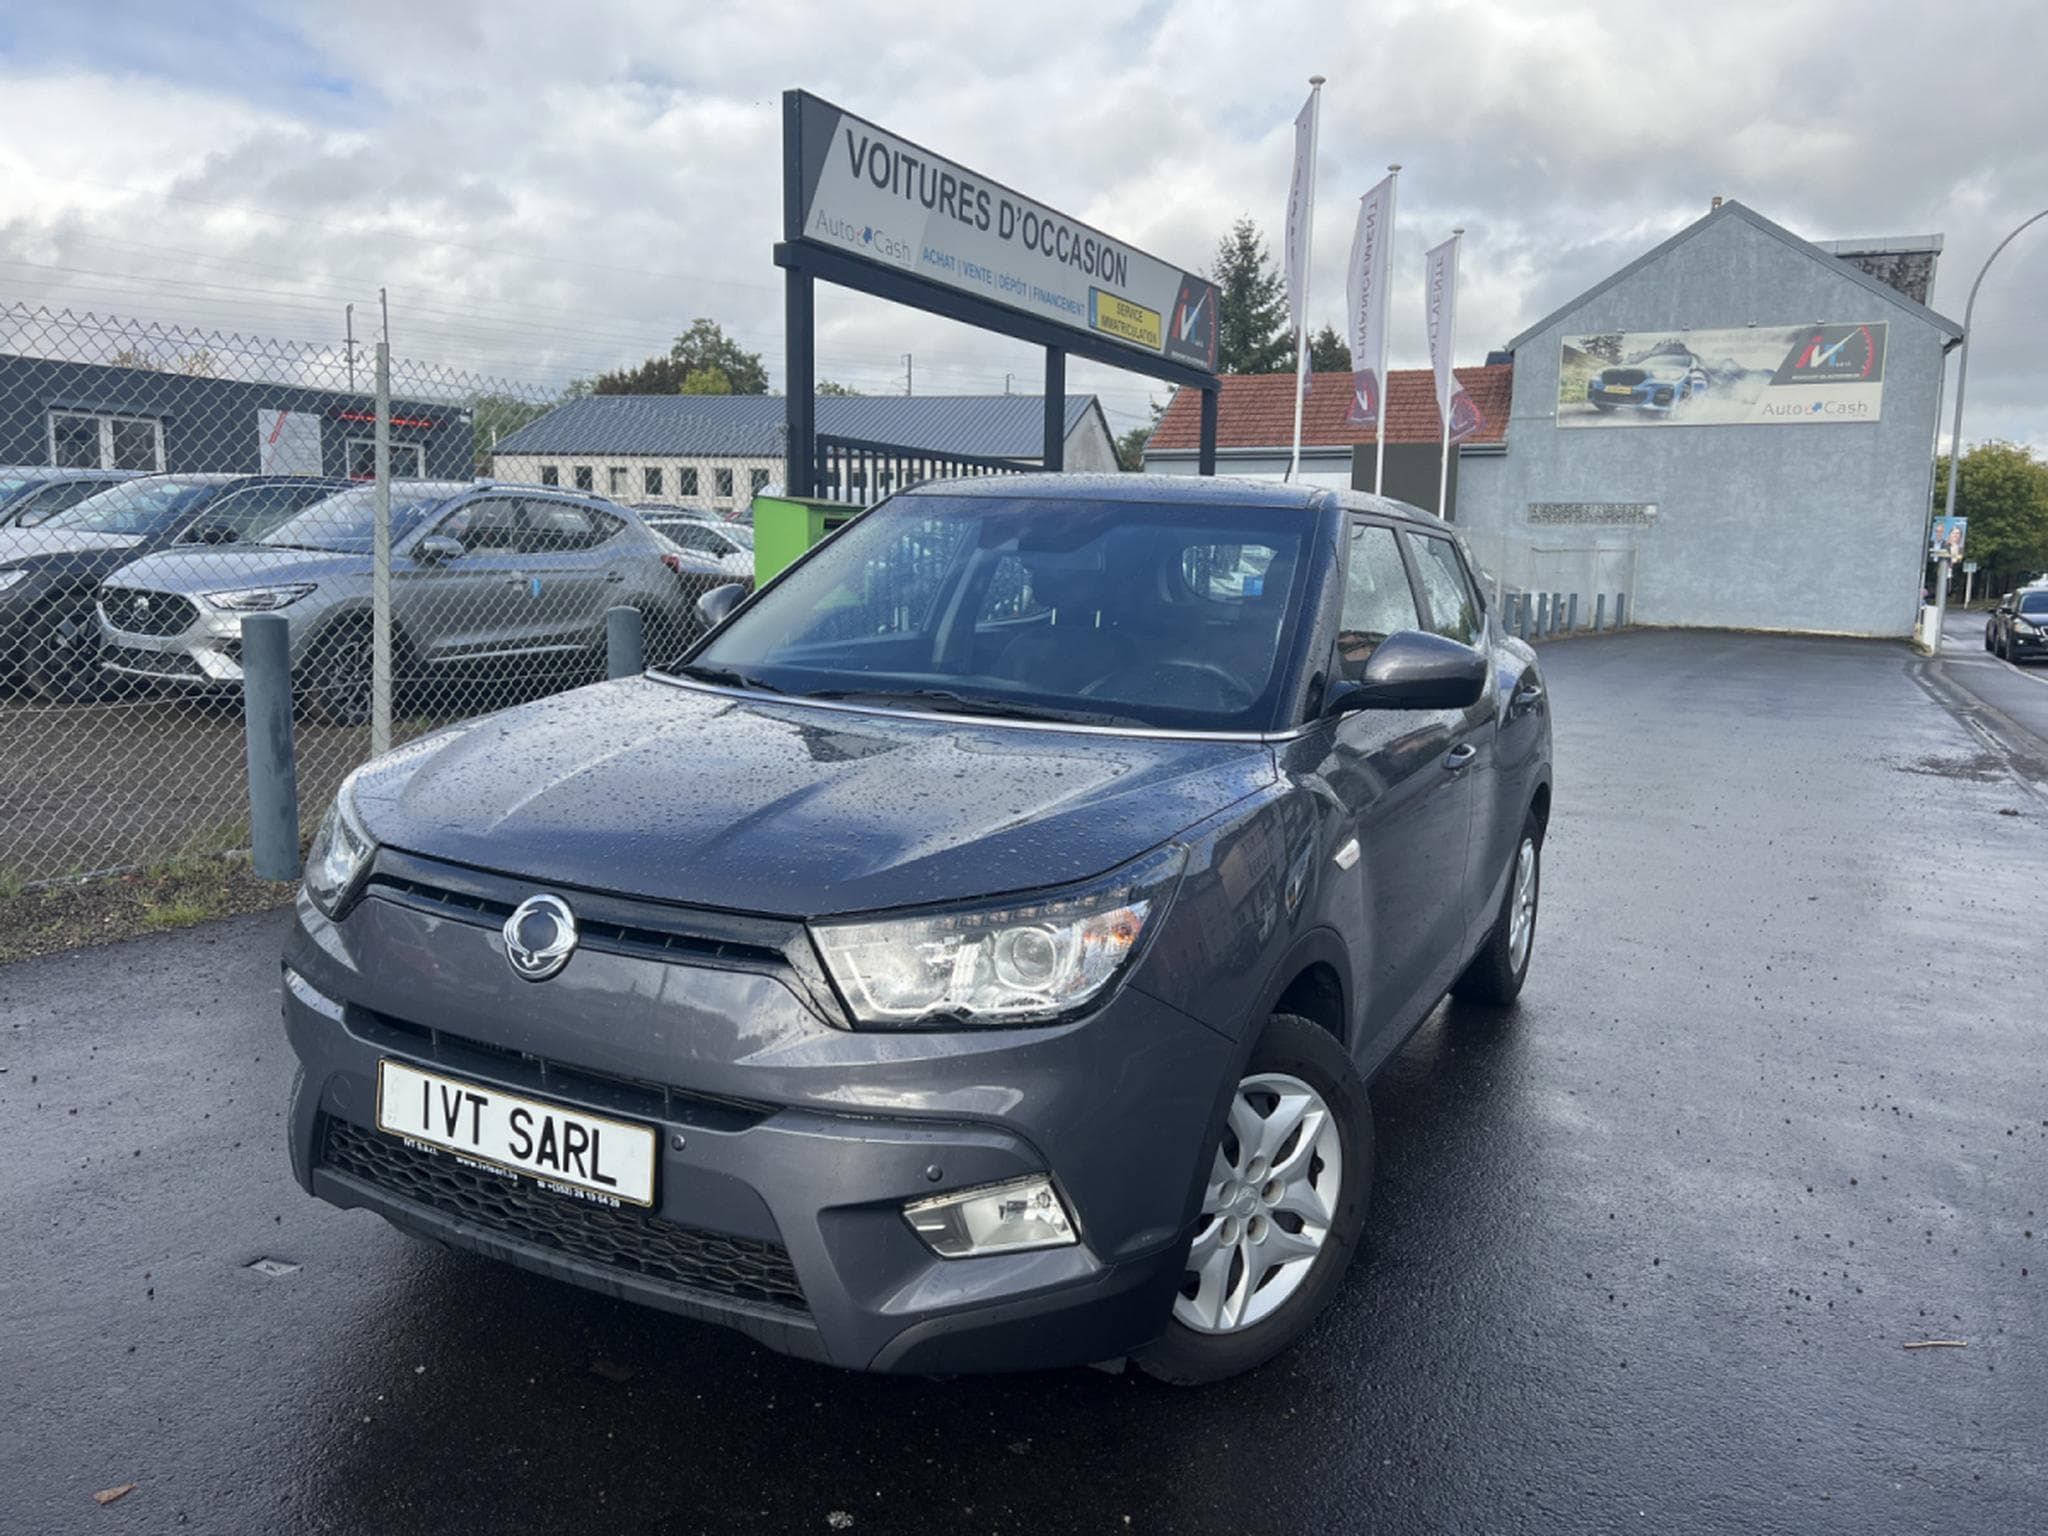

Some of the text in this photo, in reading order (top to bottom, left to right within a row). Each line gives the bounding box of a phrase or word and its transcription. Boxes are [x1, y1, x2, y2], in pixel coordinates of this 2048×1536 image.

[815, 209, 911, 261] Auto Cash
[846, 129, 1127, 287] VOITURES D'OCCASION
[922, 247, 956, 271] ACHAT
[963, 262, 992, 284] VENTE
[1033, 287, 1085, 316] FINANCEMENT
[1116, 302, 1143, 323] SERVICE
[1762, 400, 1868, 416] Auto Cash
[422, 1080, 617, 1186] IVT SARL
